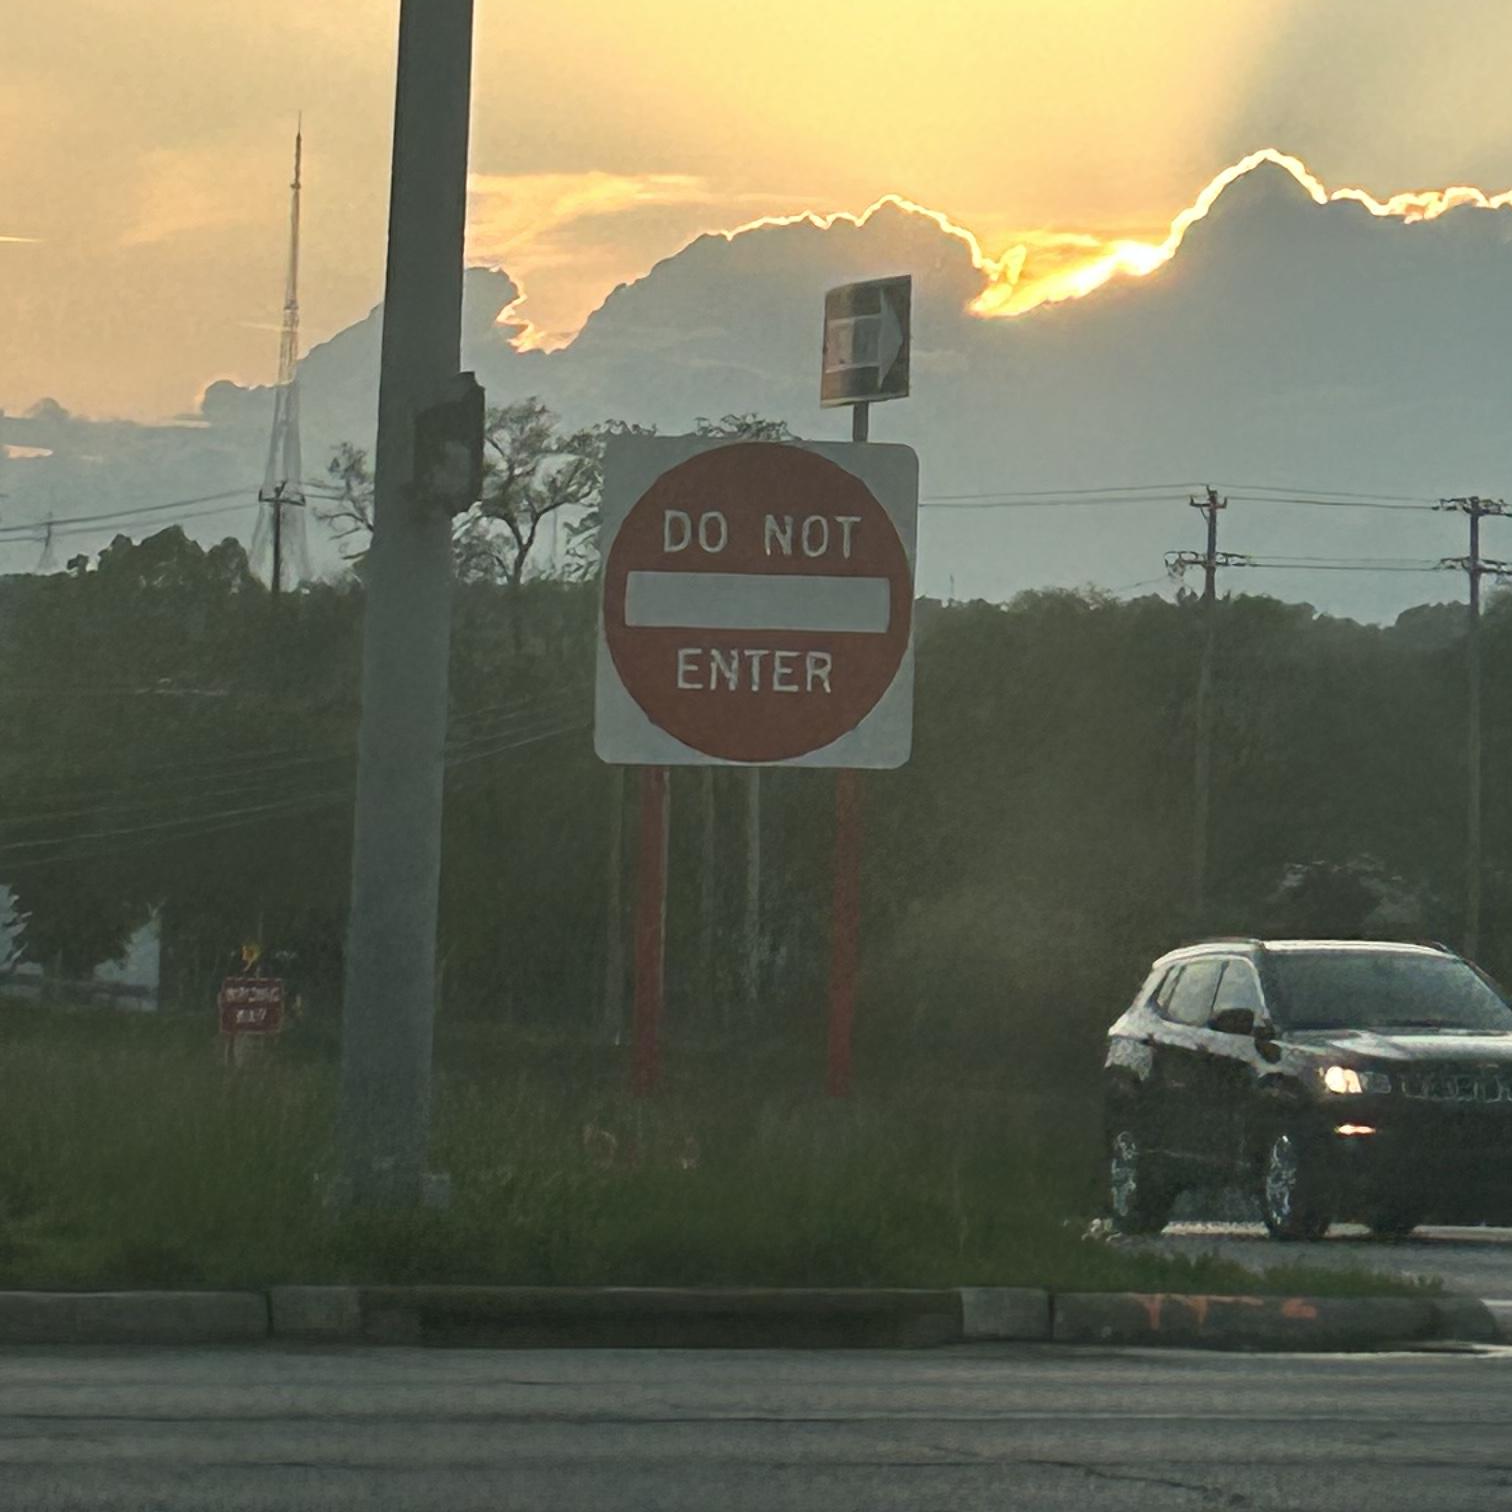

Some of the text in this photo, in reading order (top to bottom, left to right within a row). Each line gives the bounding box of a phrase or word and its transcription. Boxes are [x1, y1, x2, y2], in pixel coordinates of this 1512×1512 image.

[663, 509, 862, 559] DO NOT
[677, 648, 832, 693] ENTER
